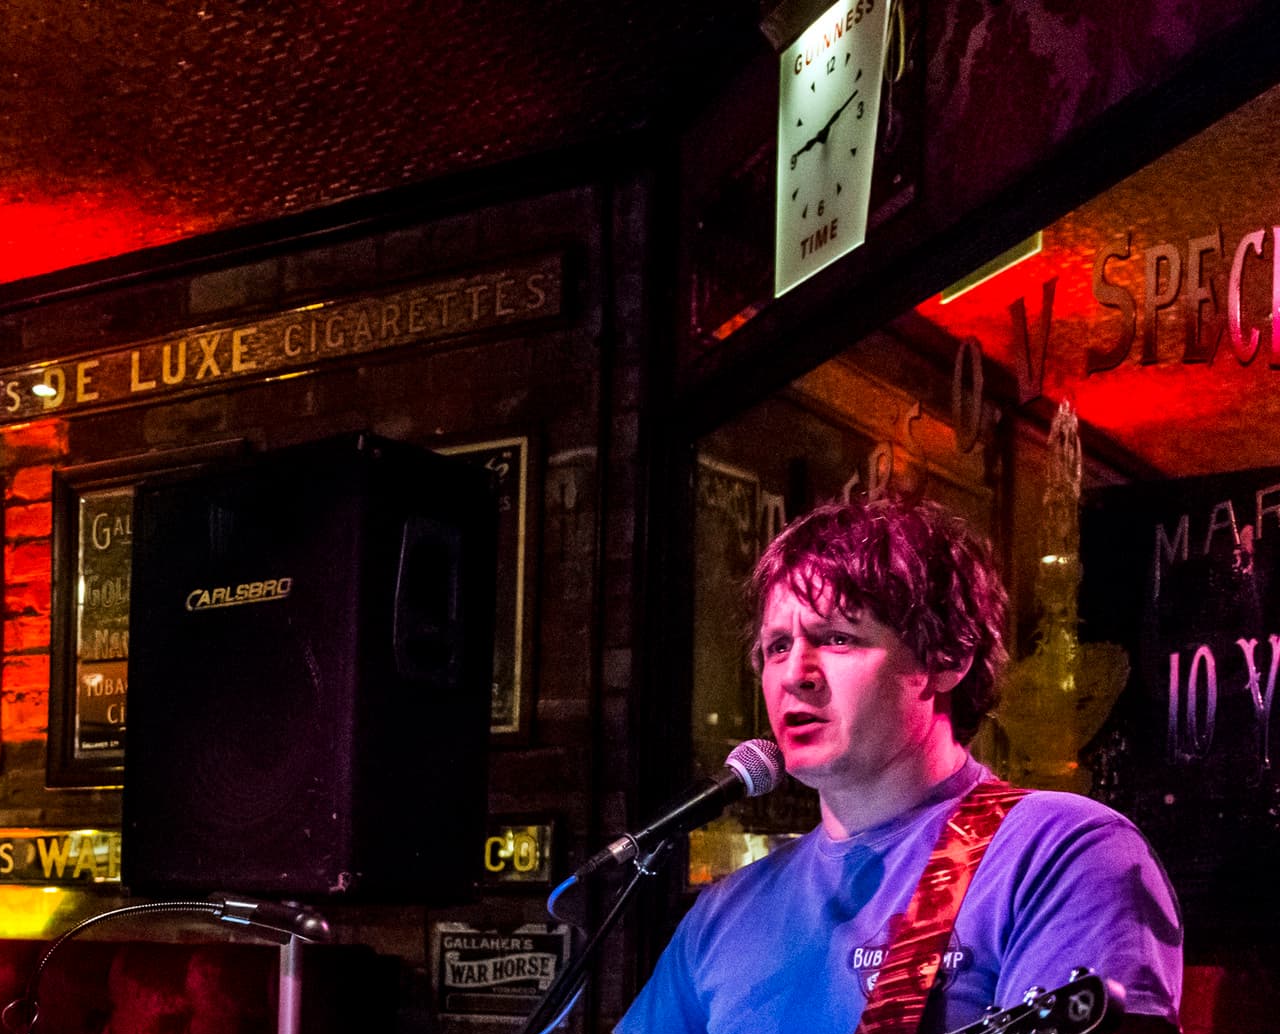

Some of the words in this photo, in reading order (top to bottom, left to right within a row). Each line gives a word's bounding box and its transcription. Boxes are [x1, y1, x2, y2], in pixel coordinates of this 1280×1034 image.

[800, 218, 839, 260] TIME
[42, 360, 99, 409] DE
[130, 328, 258, 392] LUXE
[282, 277, 547, 358] CIGARETTES
[185, 577, 294, 611] CARLSBRO
[450, 962, 488, 984] WAR
[492, 955, 551, 981] HORSE
